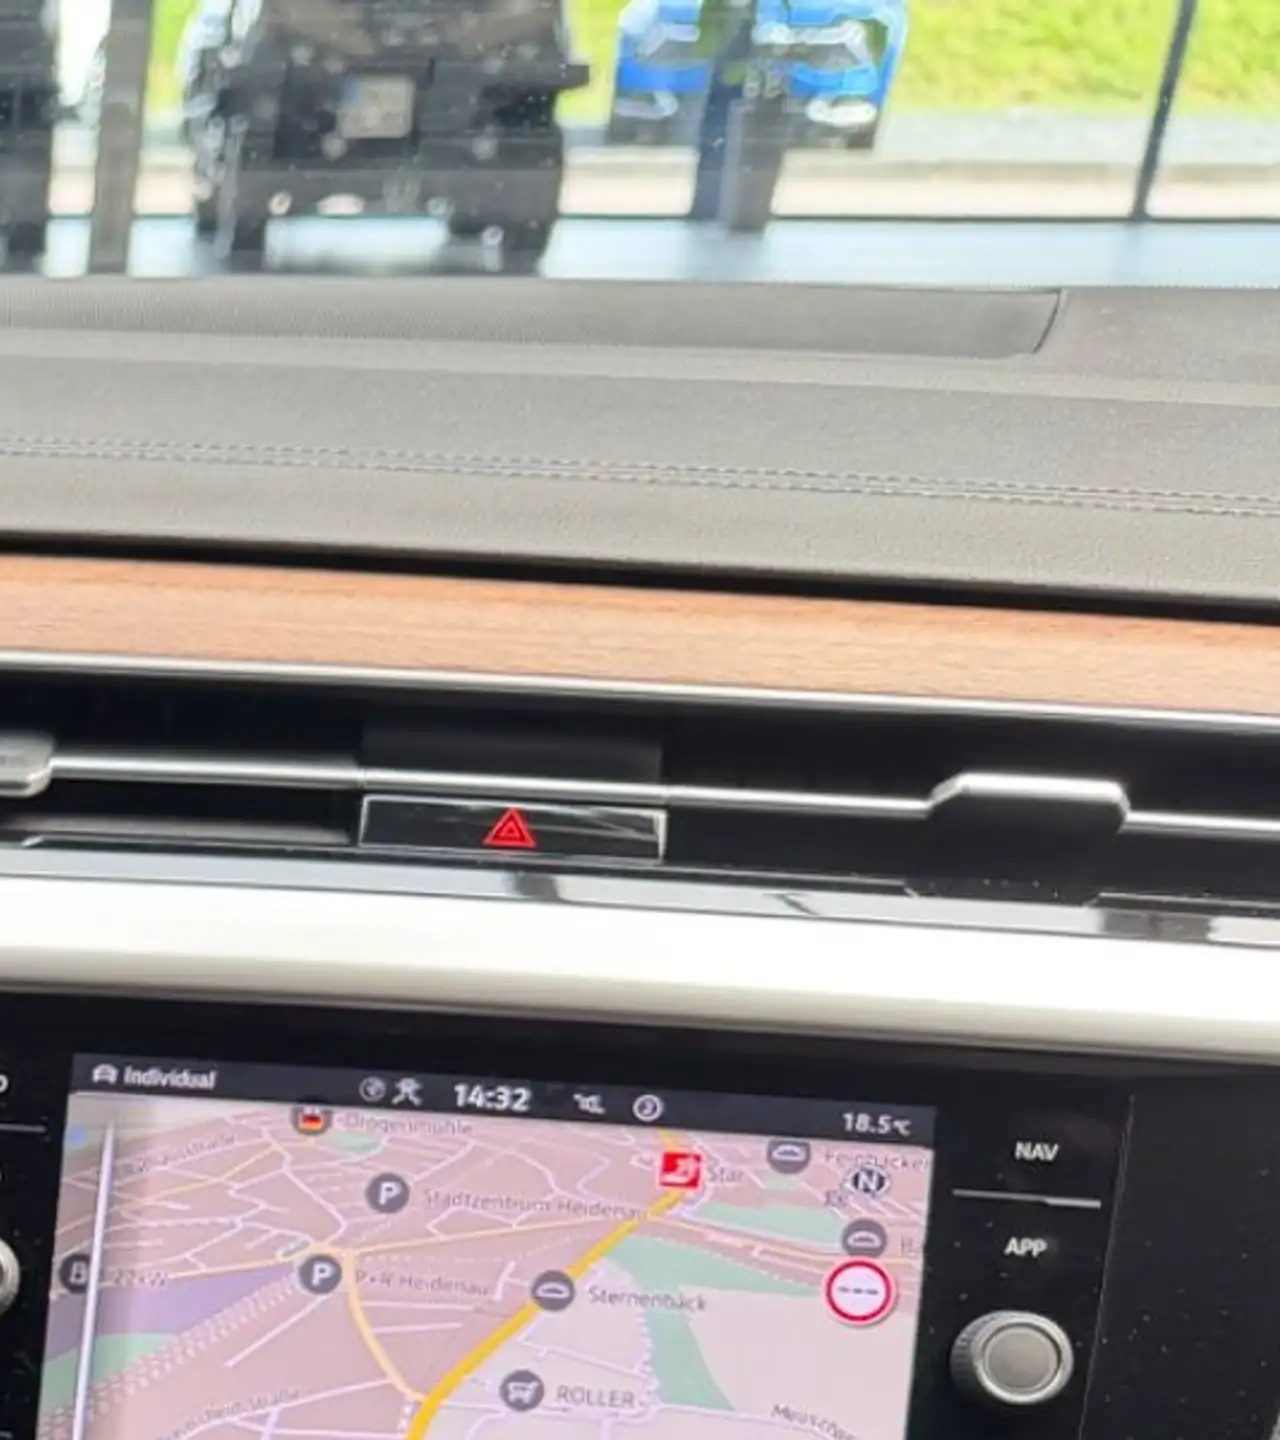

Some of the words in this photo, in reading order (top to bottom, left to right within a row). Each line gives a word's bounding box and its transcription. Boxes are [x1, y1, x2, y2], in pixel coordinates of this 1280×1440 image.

[123, 1066, 218, 1090] Individual
[453, 1084, 531, 1112] 14:32
[1015, 1141, 1059, 1162] NAV
[379, 1181, 402, 1206] P
[1004, 1237, 1048, 1258] APP
[312, 1263, 336, 1286] P
